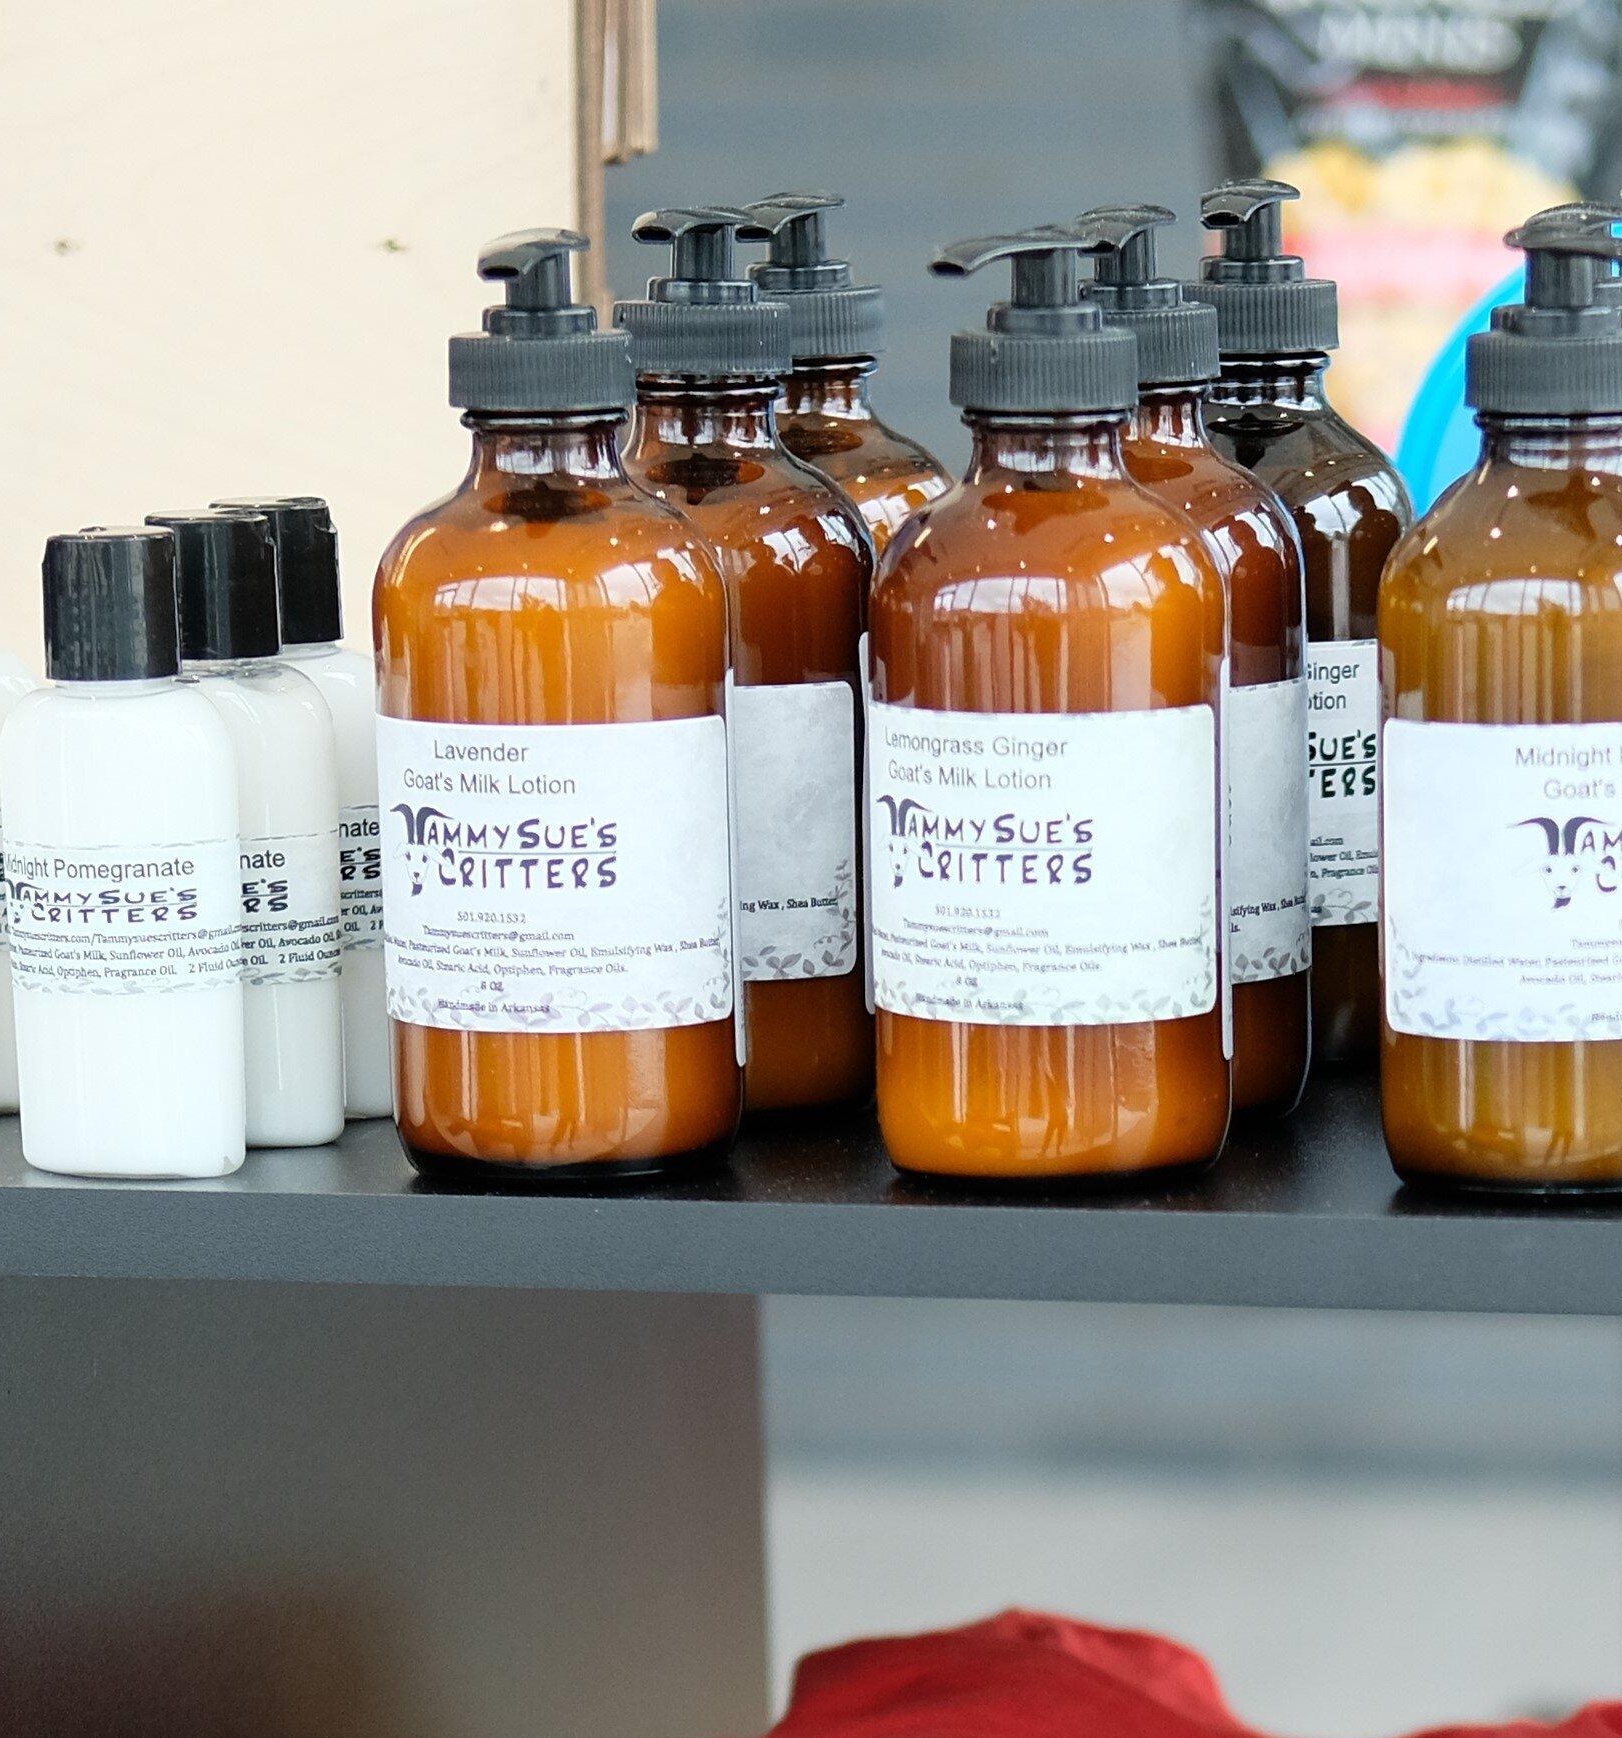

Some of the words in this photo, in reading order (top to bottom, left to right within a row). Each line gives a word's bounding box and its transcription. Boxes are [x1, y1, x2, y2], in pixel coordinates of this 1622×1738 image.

[434, 740, 530, 762] Lavender
[884, 726, 985, 757] Lemongrass
[992, 736, 1069, 761] Ginger
[1515, 741, 1613, 771] Midnight
[403, 768, 454, 792] Goat's
[460, 773, 501, 793] Milk
[508, 775, 576, 794] Lotion
[888, 759, 933, 785] Goat's
[938, 766, 977, 788] Milk
[985, 768, 1052, 790] Lotion
[1543, 777, 1617, 801] Goat's
[53, 856, 196, 883] Pomegranate
[438, 848, 618, 889] CRITTERS
[918, 840, 1094, 885] CRITTERS
[31, 902, 198, 924] CRITTERS
[109, 948, 165, 961] Sunflower
